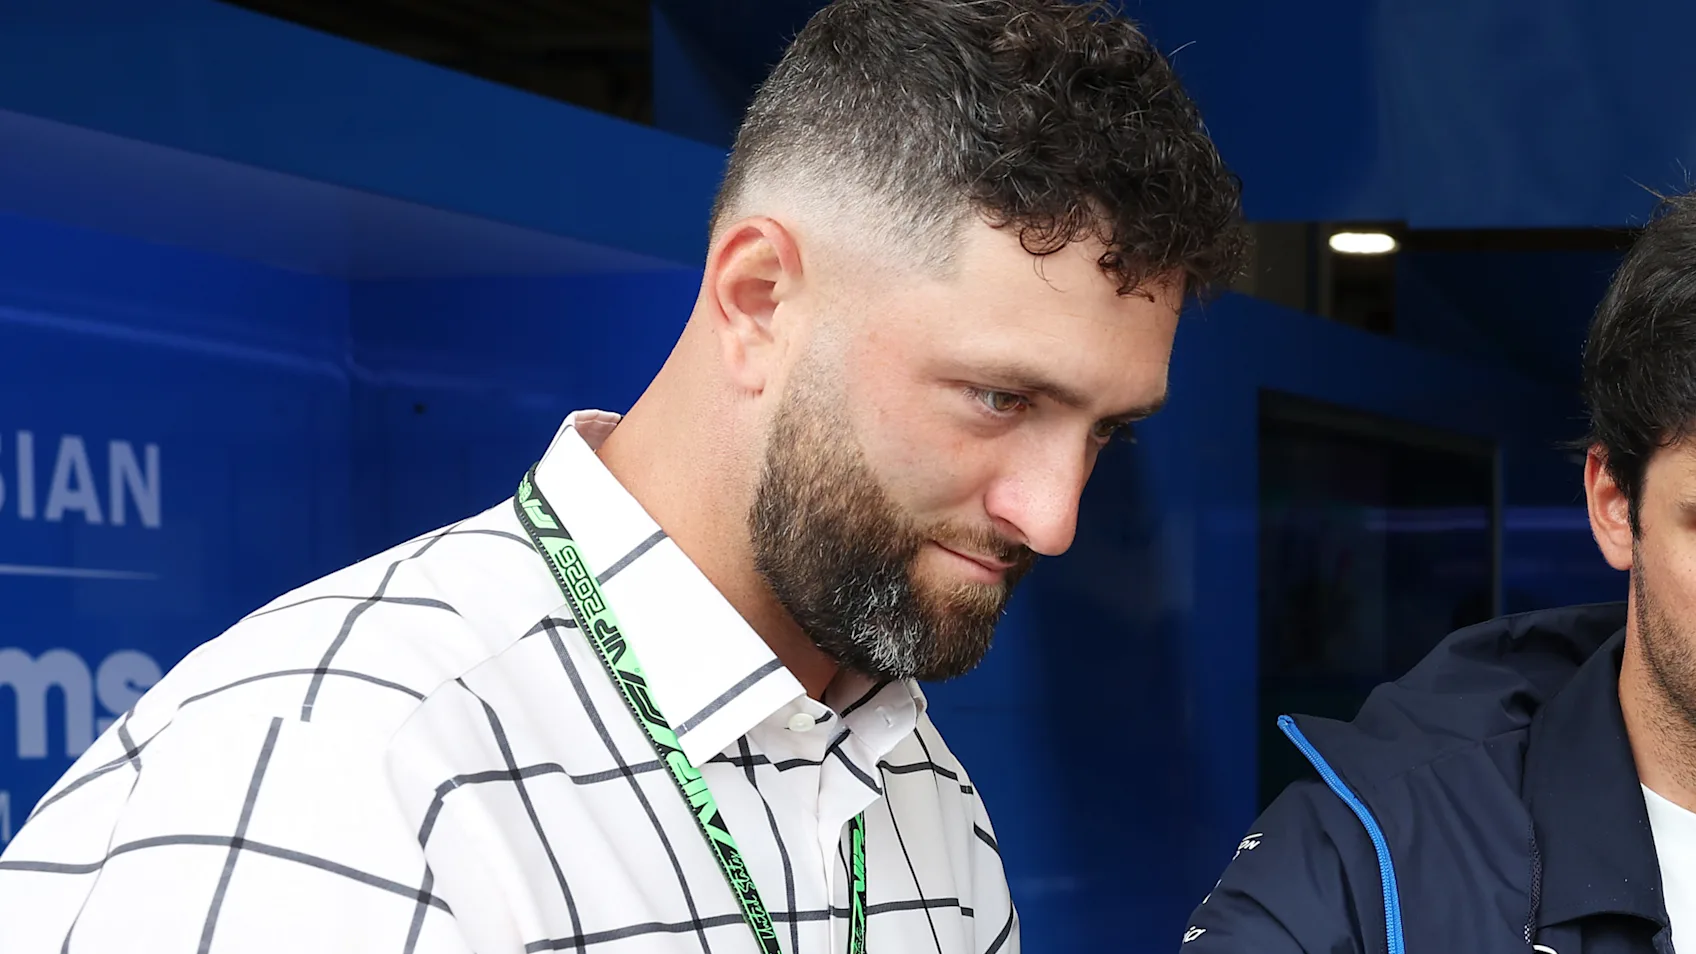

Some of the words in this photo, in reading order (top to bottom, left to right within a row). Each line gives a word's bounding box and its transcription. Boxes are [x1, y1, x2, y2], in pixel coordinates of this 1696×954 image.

[554, 545, 607, 620] 2026
[593, 618, 627, 666] VIP
[727, 851, 756, 893] States
[745, 894, 776, 940] United
